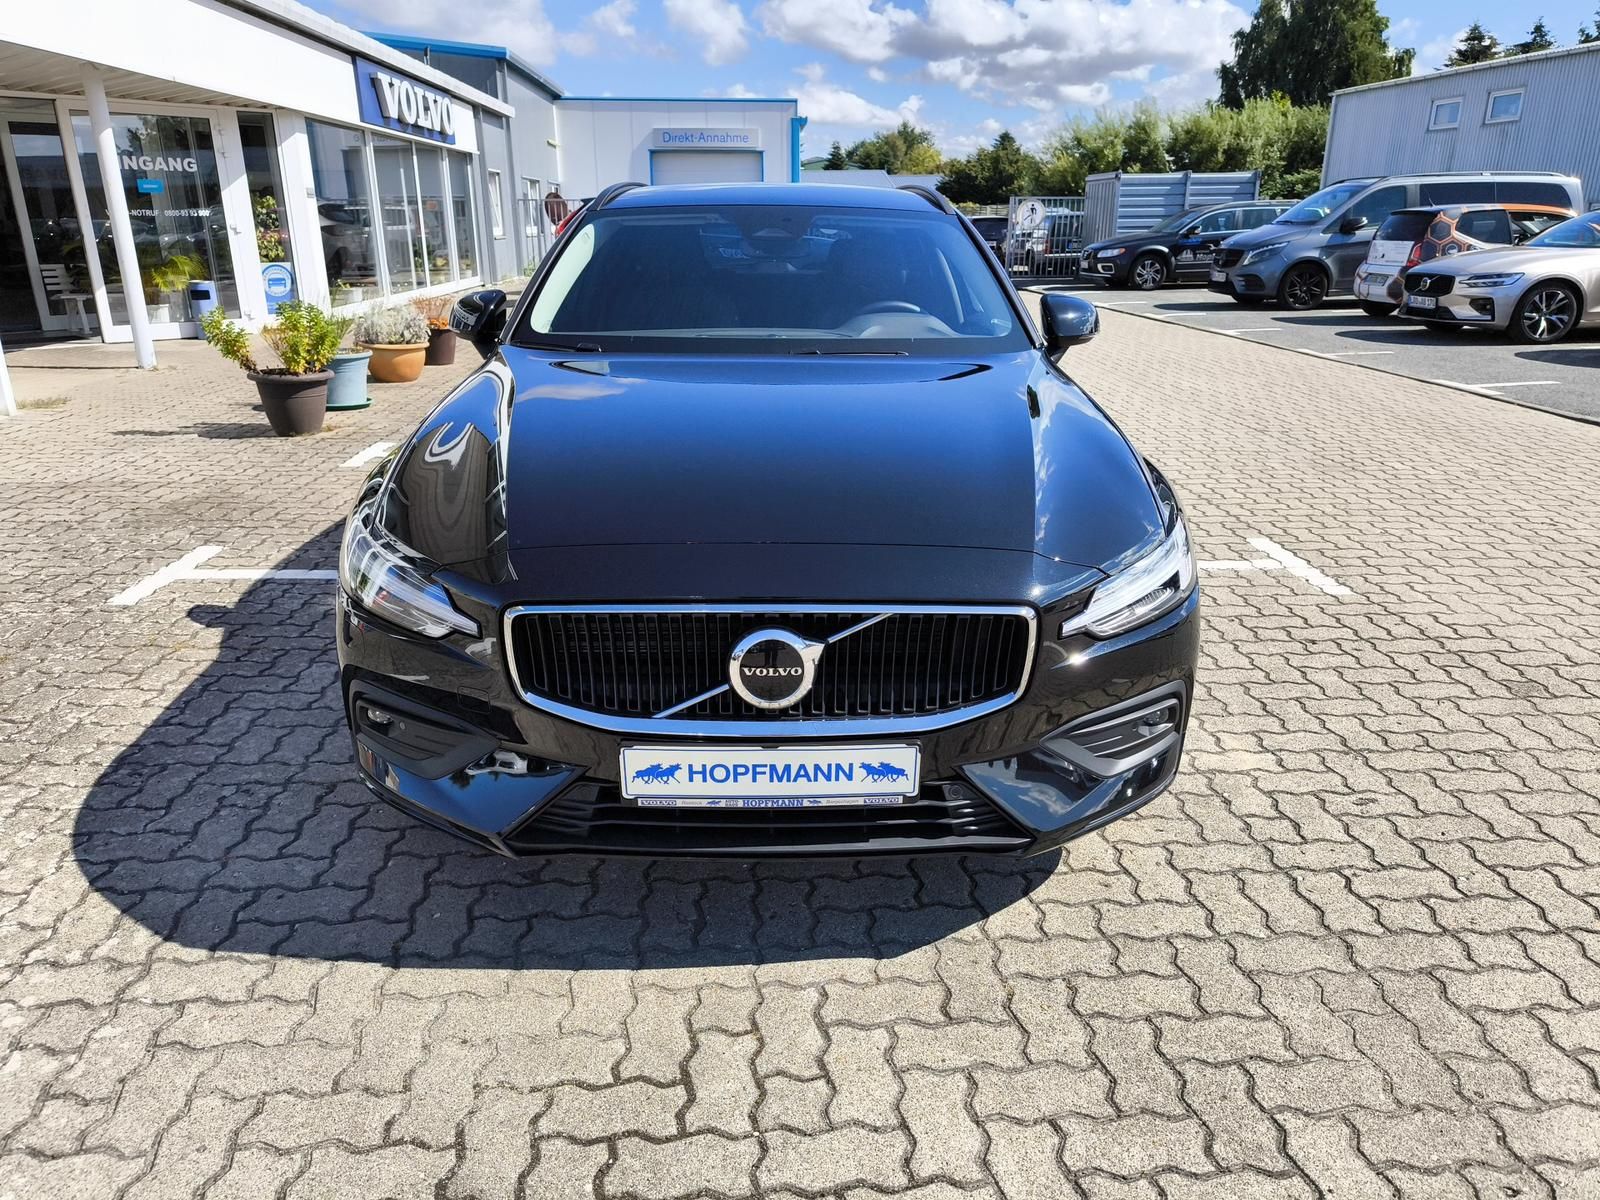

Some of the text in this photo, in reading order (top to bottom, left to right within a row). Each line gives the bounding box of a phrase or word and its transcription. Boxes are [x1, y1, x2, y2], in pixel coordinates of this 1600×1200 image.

[373, 72, 454, 135] VOLVO
[662, 131, 750, 143] Direkt-Annahme
[117, 155, 198, 172] INGANG
[743, 666, 802, 676] VOLVO
[687, 763, 854, 783] HOPFMANN
[743, 799, 804, 807] HOPFMANN
